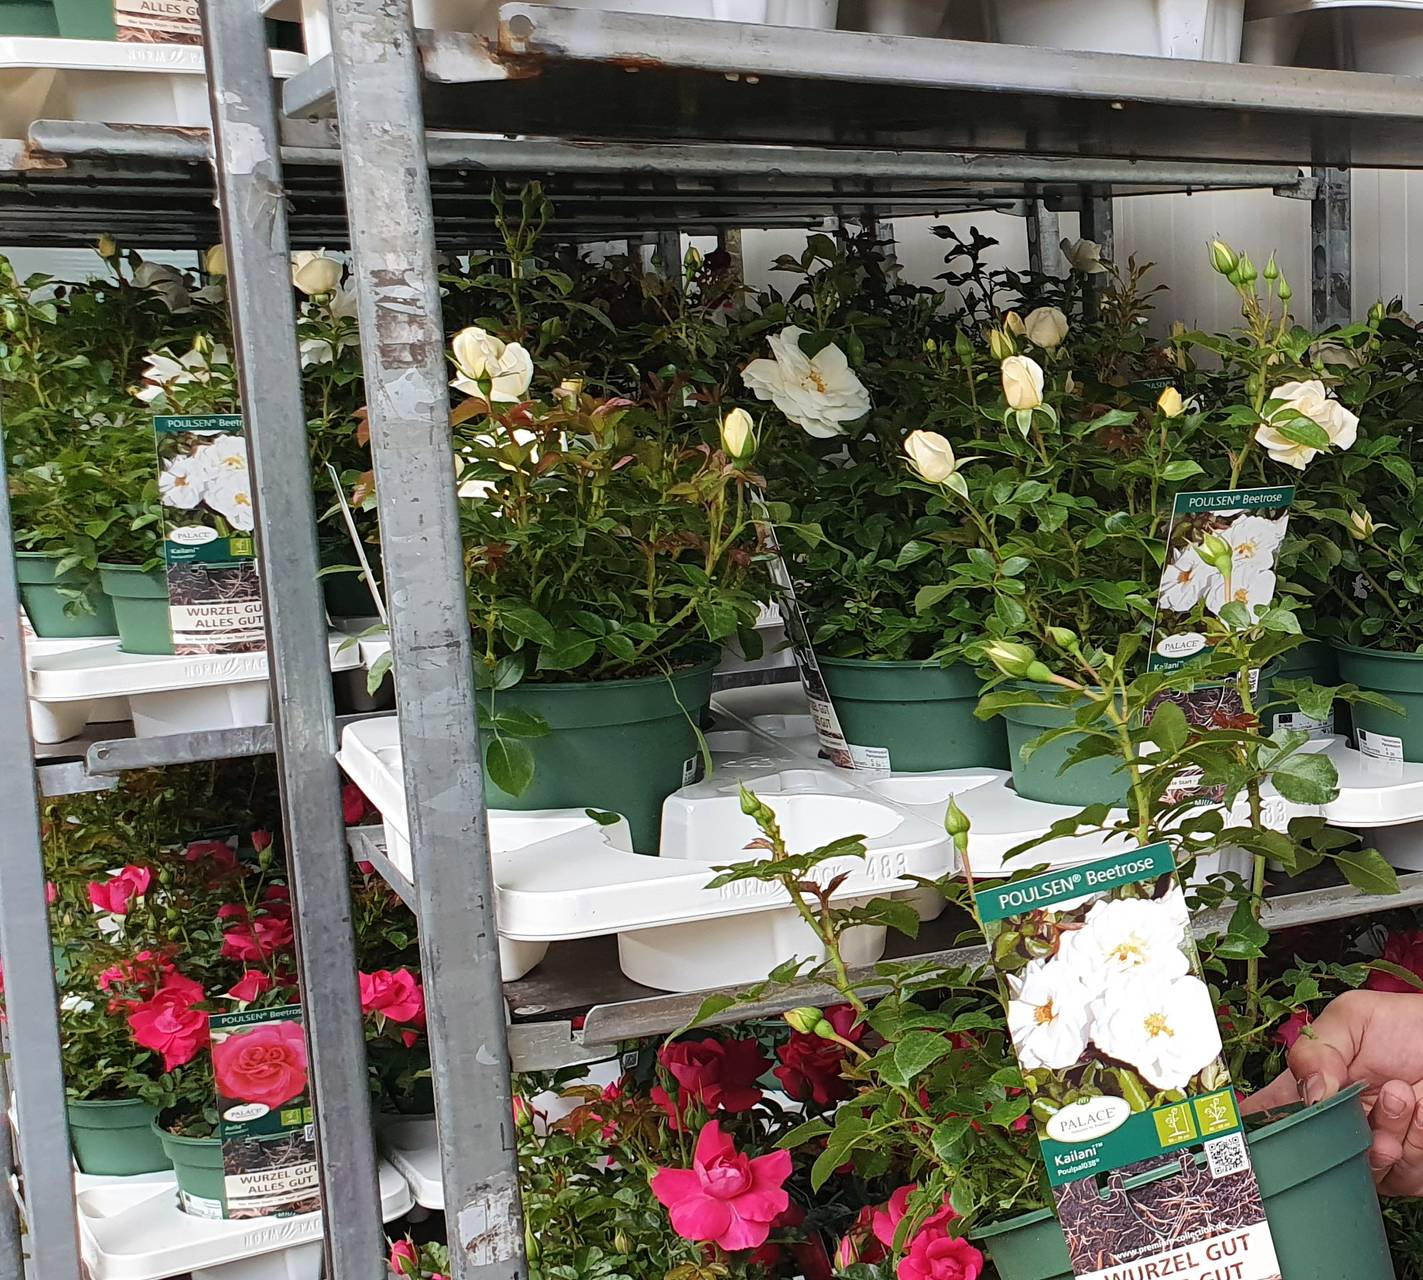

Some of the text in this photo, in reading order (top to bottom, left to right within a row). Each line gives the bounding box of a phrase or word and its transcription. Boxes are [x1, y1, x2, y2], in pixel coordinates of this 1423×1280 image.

[140, 2, 181, 15] ALLES
[1242, 493, 1282, 505] Beetrose
[186, 606, 240, 617] WURZEL
[195, 615, 263, 628] ALLES GUT
[866, 852, 909, 882] 483
[999, 857, 1155, 910] POULSEN® Beetrose
[240, 1171, 291, 1185] WURZEL
[248, 1175, 314, 1194] ALLES GUT
[1205, 1233, 1250, 1261] GUT
